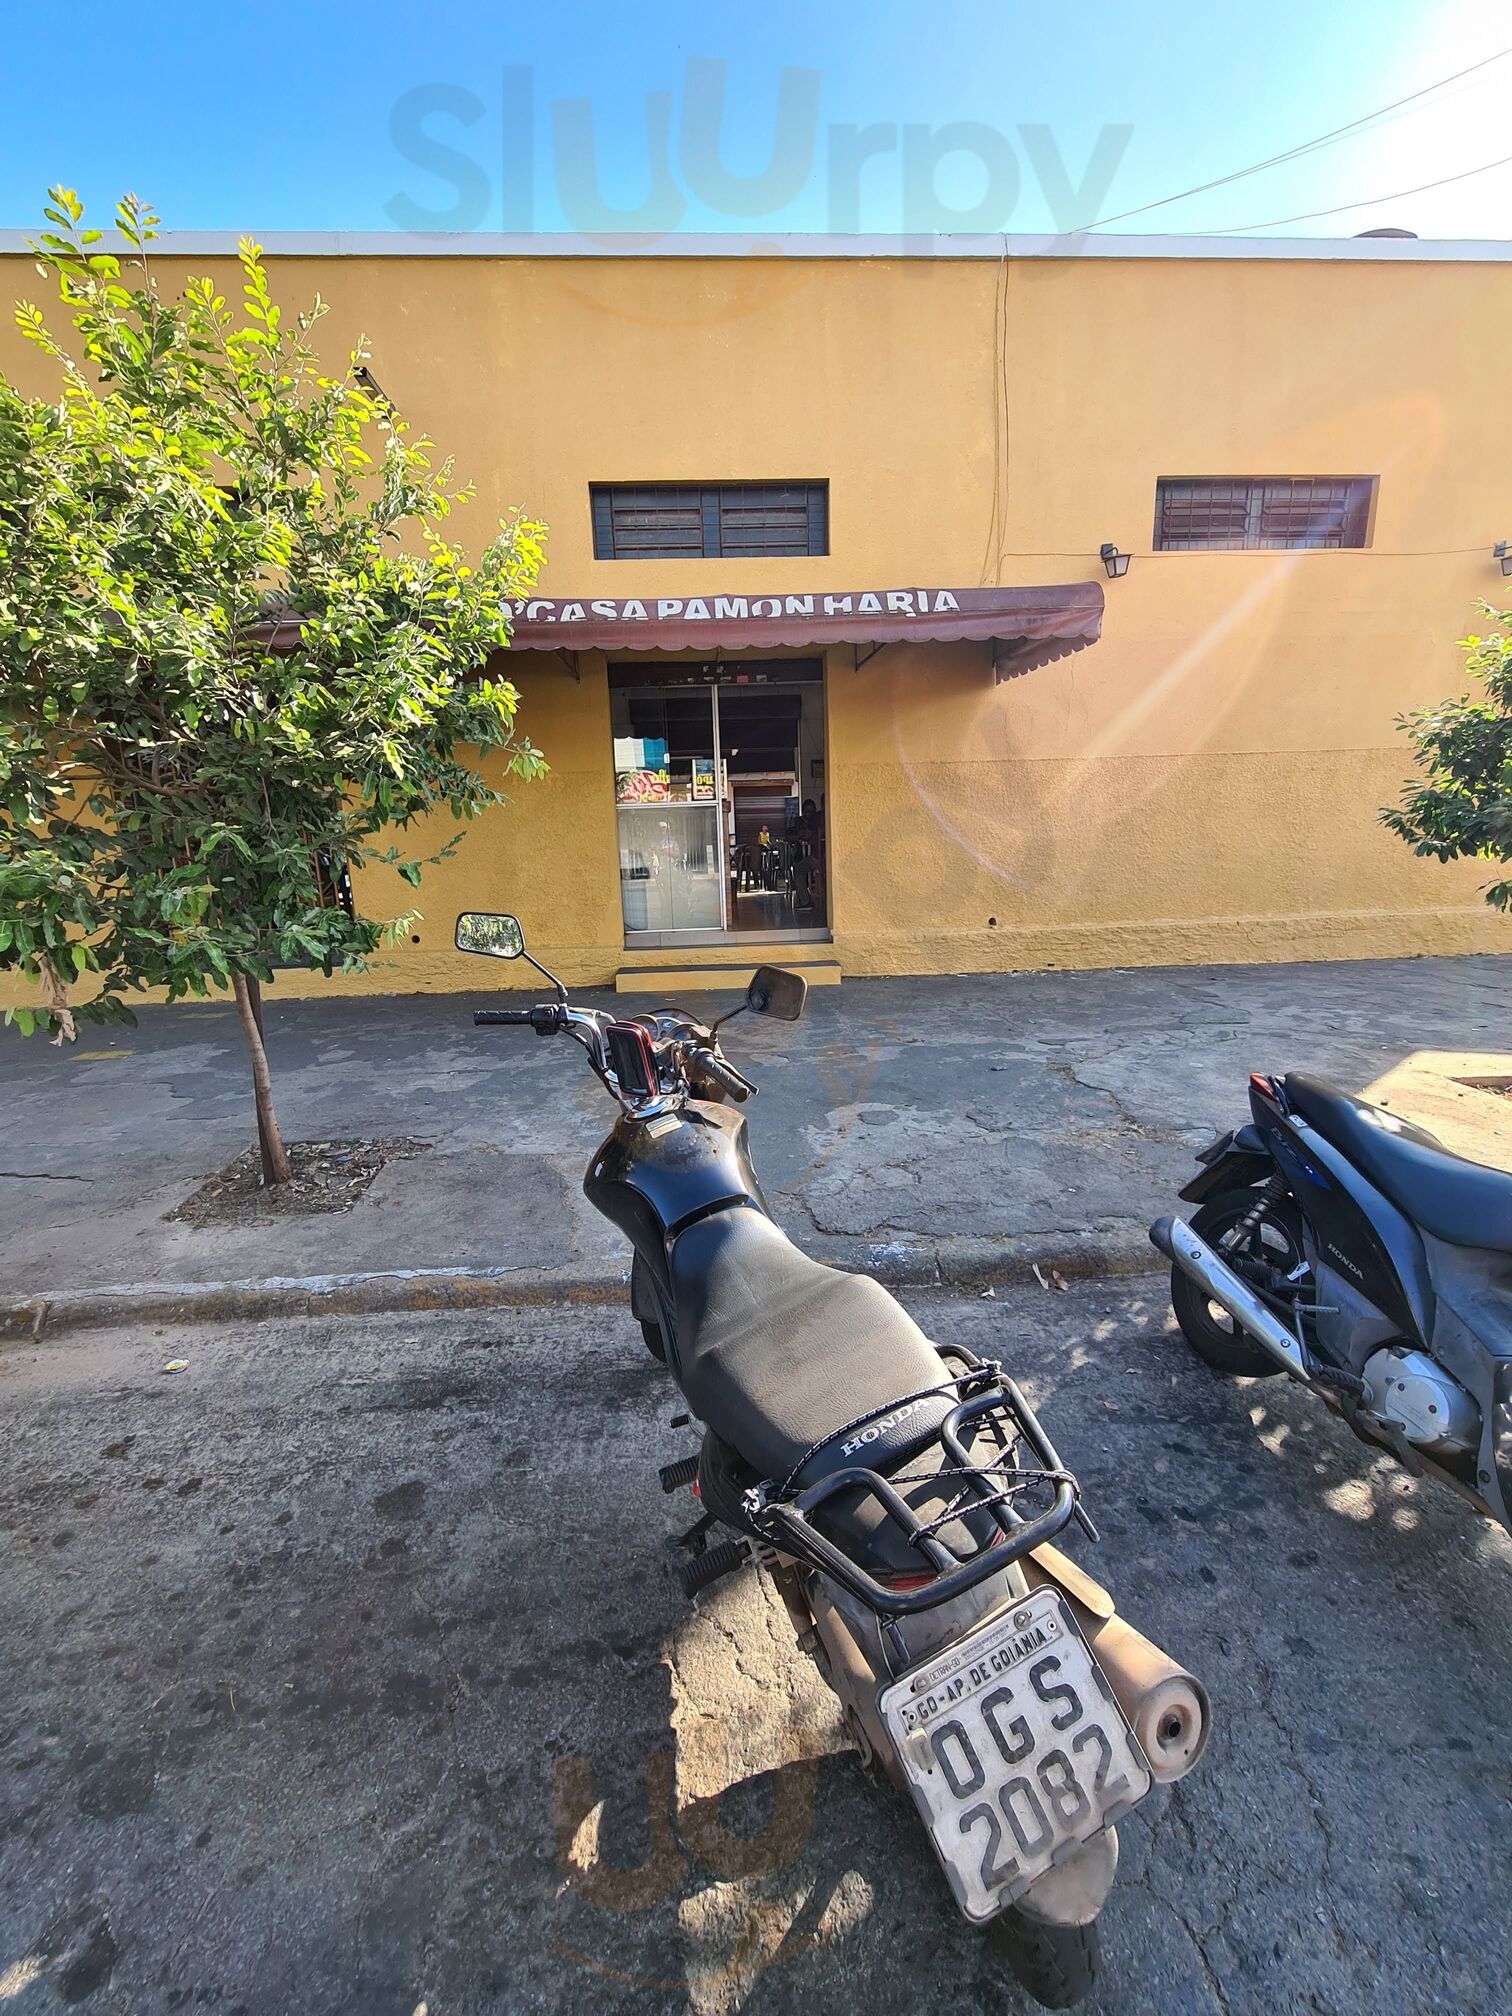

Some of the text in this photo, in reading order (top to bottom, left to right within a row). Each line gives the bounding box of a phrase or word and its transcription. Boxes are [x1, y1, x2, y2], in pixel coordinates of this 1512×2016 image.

[657, 590, 961, 621] PAMONHARIA
[1327, 1242, 1364, 1280] HONDA
[840, 1400, 932, 1458] HONDA
[969, 1661, 992, 1687] DE
[930, 1655, 1084, 1800] OGS
[958, 1723, 1131, 1892] 2082
